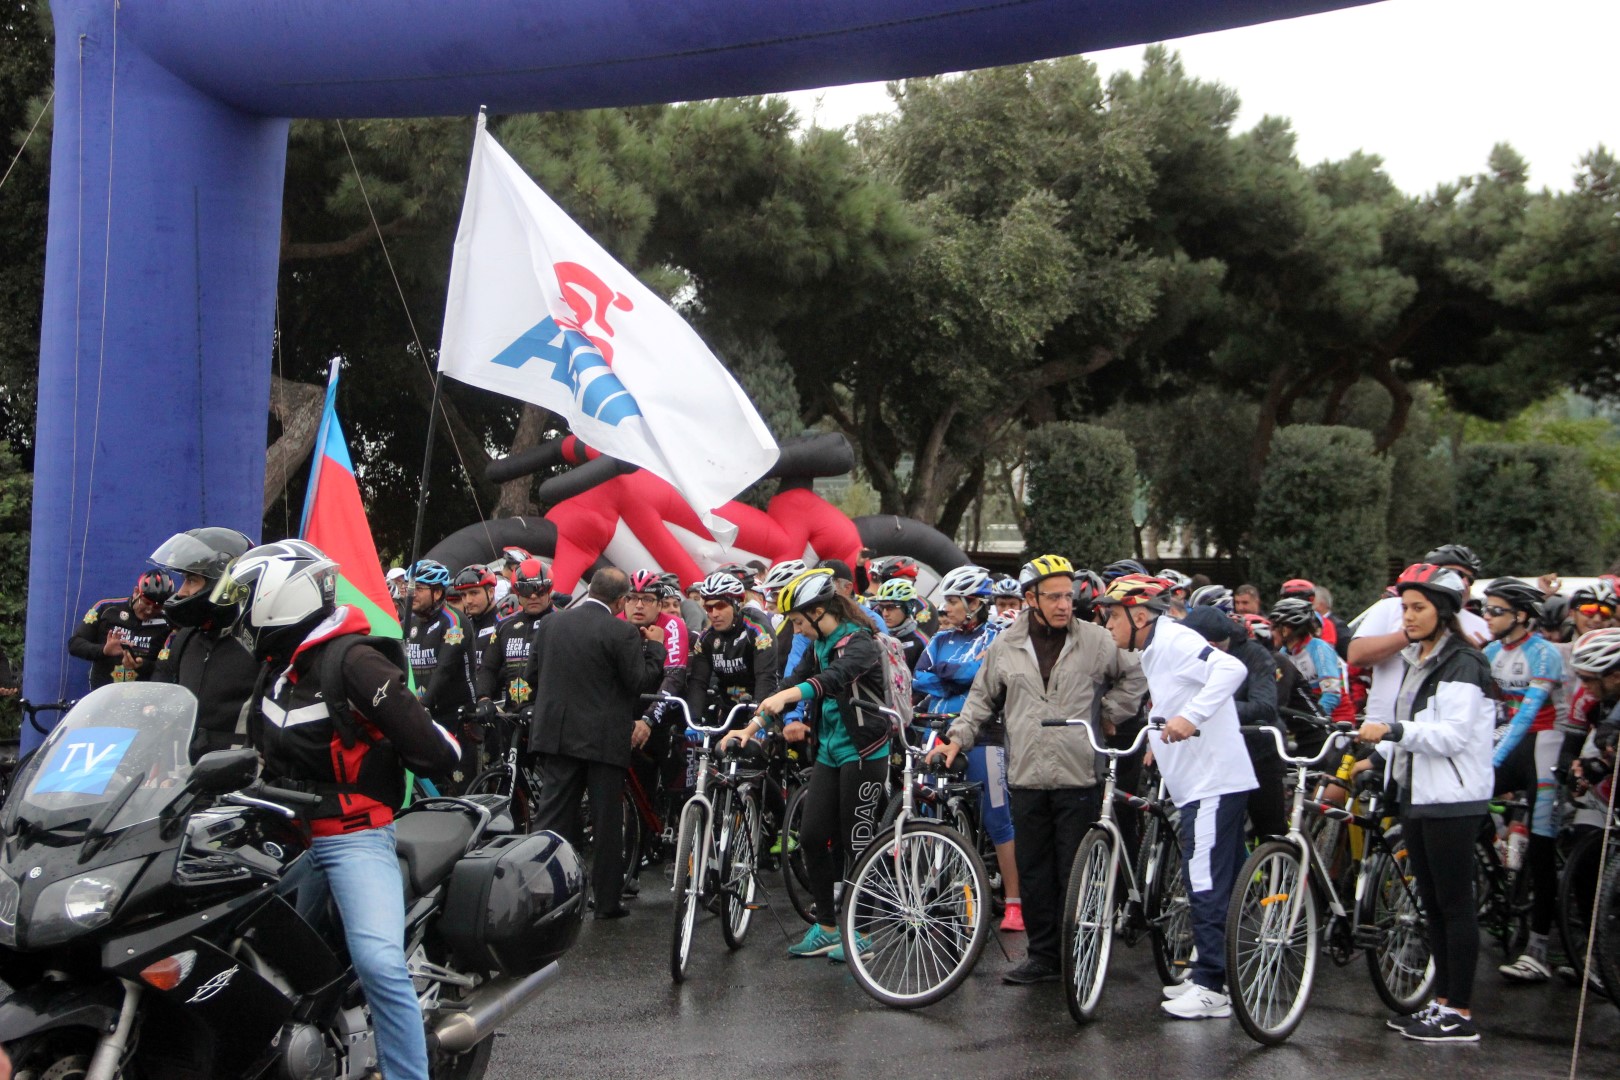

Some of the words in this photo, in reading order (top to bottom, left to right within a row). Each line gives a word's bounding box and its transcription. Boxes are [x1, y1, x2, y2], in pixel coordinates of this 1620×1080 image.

[506, 643, 531, 651] SECUR
[665, 619, 680, 663] BAKU
[60, 742, 117, 774] TV
[686, 747, 695, 788] BAKU
